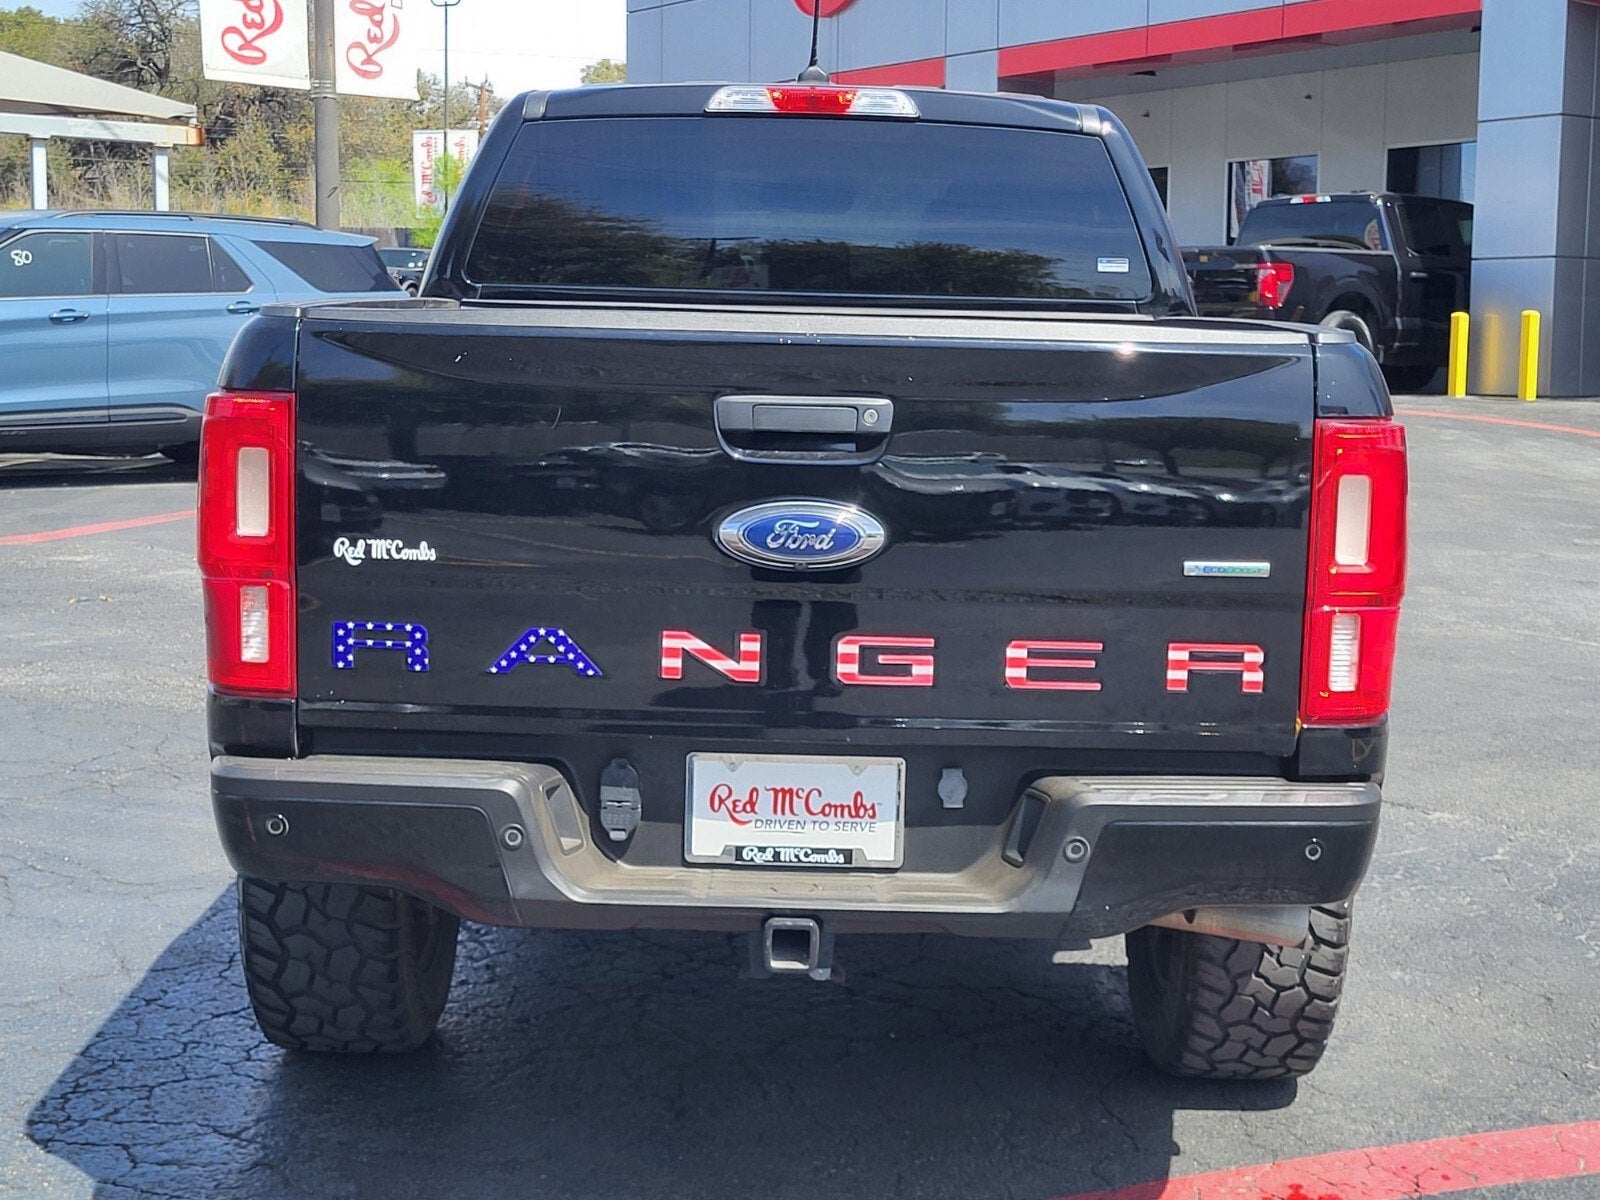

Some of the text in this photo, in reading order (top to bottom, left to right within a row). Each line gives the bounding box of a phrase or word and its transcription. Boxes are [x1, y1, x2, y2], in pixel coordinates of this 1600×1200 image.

[346, 0, 399, 79] Red
[10, 249, 33, 267] 80
[766, 518, 835, 551] Ford
[333, 537, 436, 566] Red McCombs
[709, 783, 877, 826] Red McCombs
[754, 818, 877, 833] DRIVEN TO SERVE
[741, 846, 845, 864] Red McCombs
